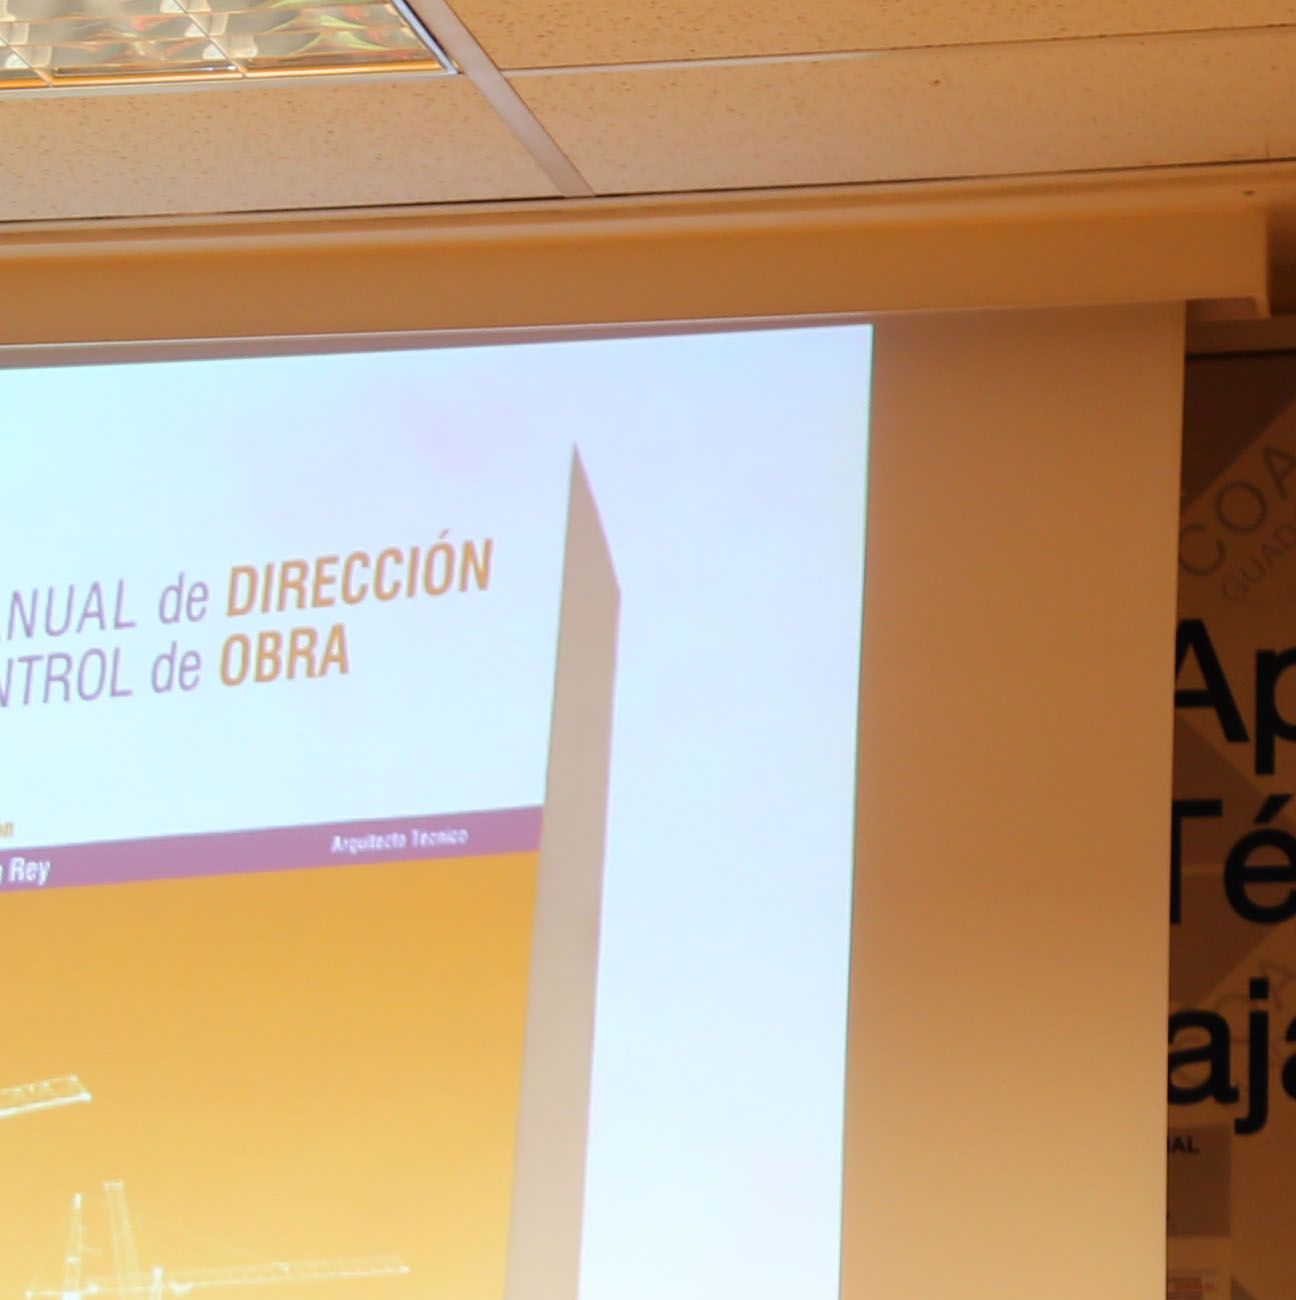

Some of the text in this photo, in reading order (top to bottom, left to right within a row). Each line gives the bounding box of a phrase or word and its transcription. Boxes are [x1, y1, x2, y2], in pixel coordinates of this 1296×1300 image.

[158, 572, 210, 625] de
[226, 530, 493, 618] DIRECCIÓN
[151, 641, 202, 694] de
[219, 623, 351, 687] OBRA
[332, 832, 407, 855] Arquitecto
[9, 857, 51, 886] Rey
